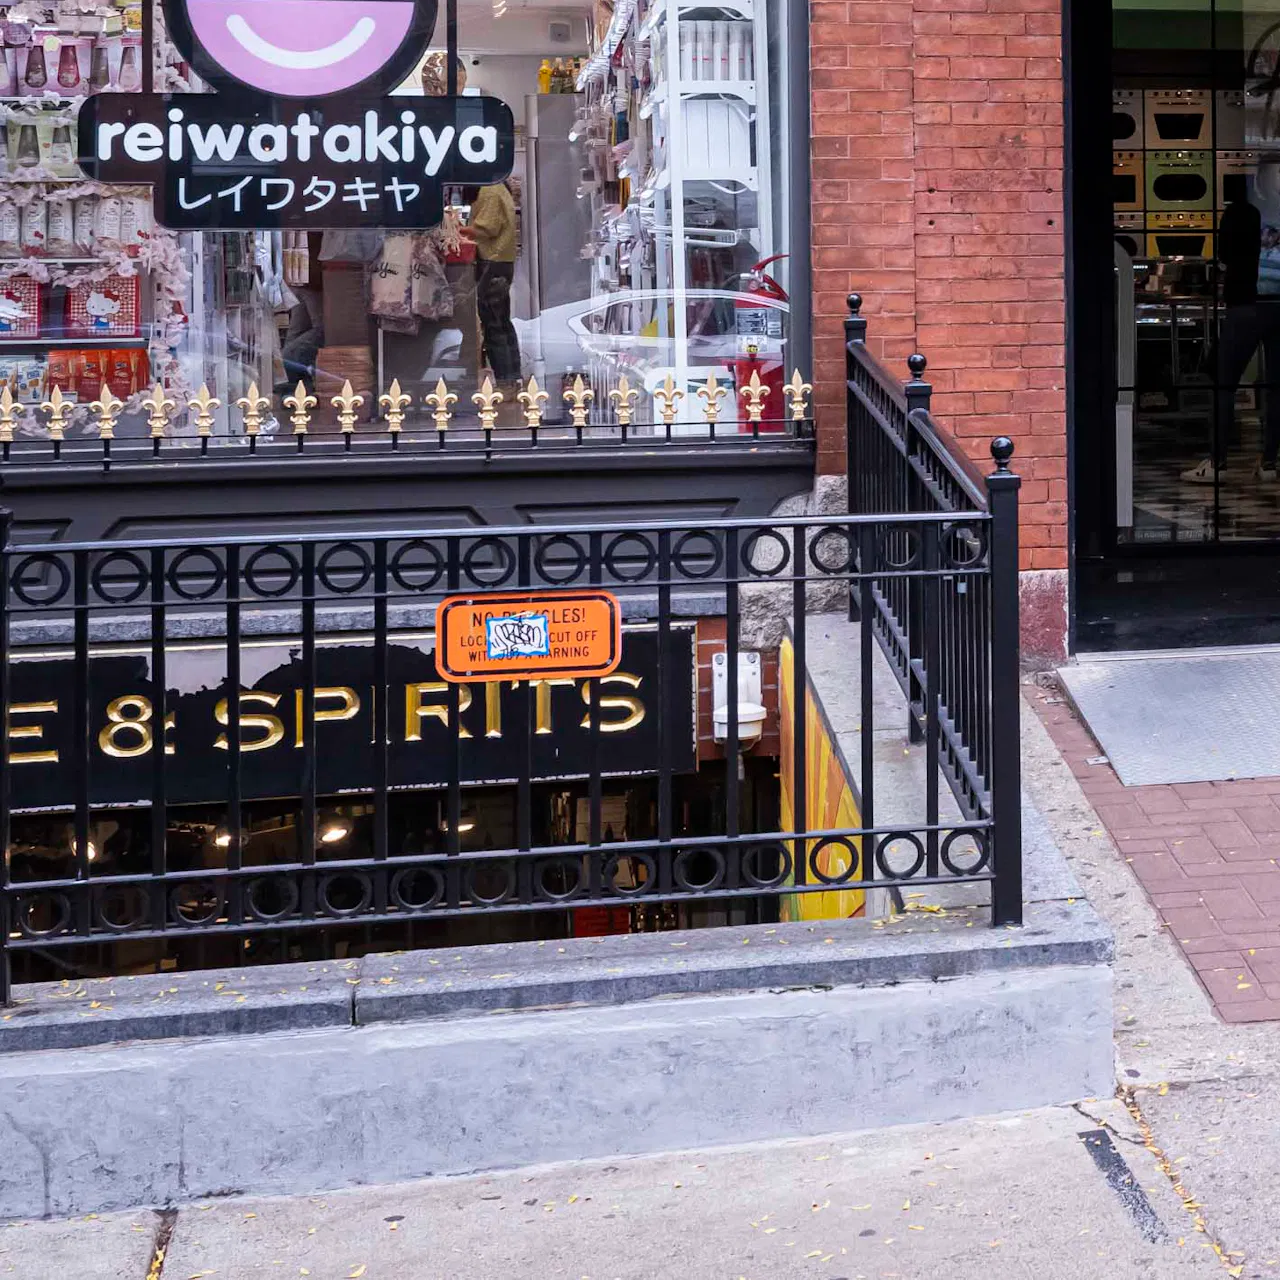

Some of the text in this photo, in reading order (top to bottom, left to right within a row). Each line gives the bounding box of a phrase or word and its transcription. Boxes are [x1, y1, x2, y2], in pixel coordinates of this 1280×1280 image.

[98, 107, 498, 177] reiwatakiya
[177, 175, 421, 213] レイワタキヤ
[549, 631, 571, 643] CUT
[575, 630, 598, 642] OFF
